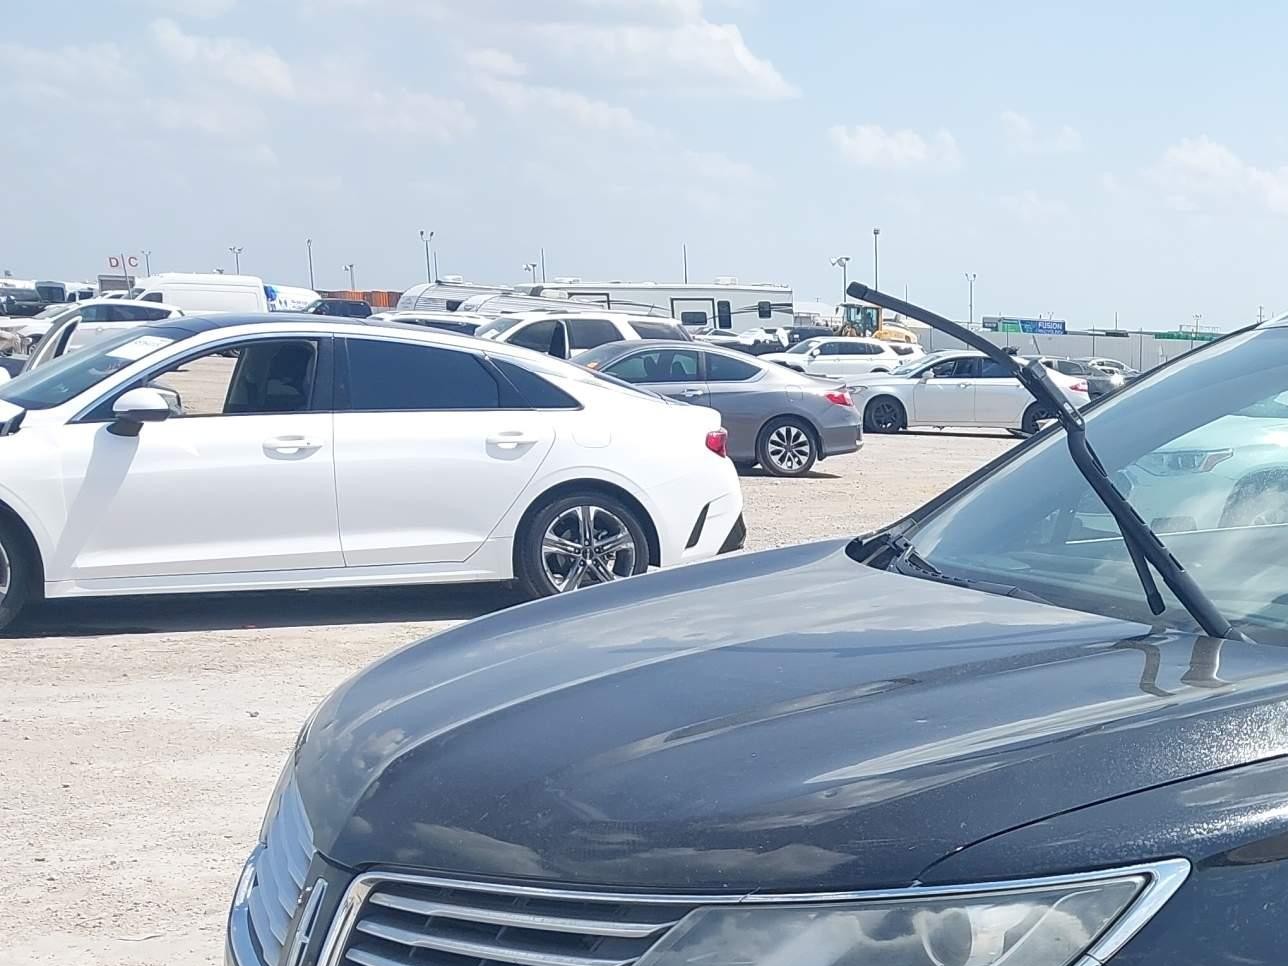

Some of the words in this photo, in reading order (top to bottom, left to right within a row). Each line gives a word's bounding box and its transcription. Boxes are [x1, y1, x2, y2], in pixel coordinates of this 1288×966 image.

[109, 256, 119, 268] D
[128, 256, 139, 268] C
[1038, 321, 1063, 331] FUSION
